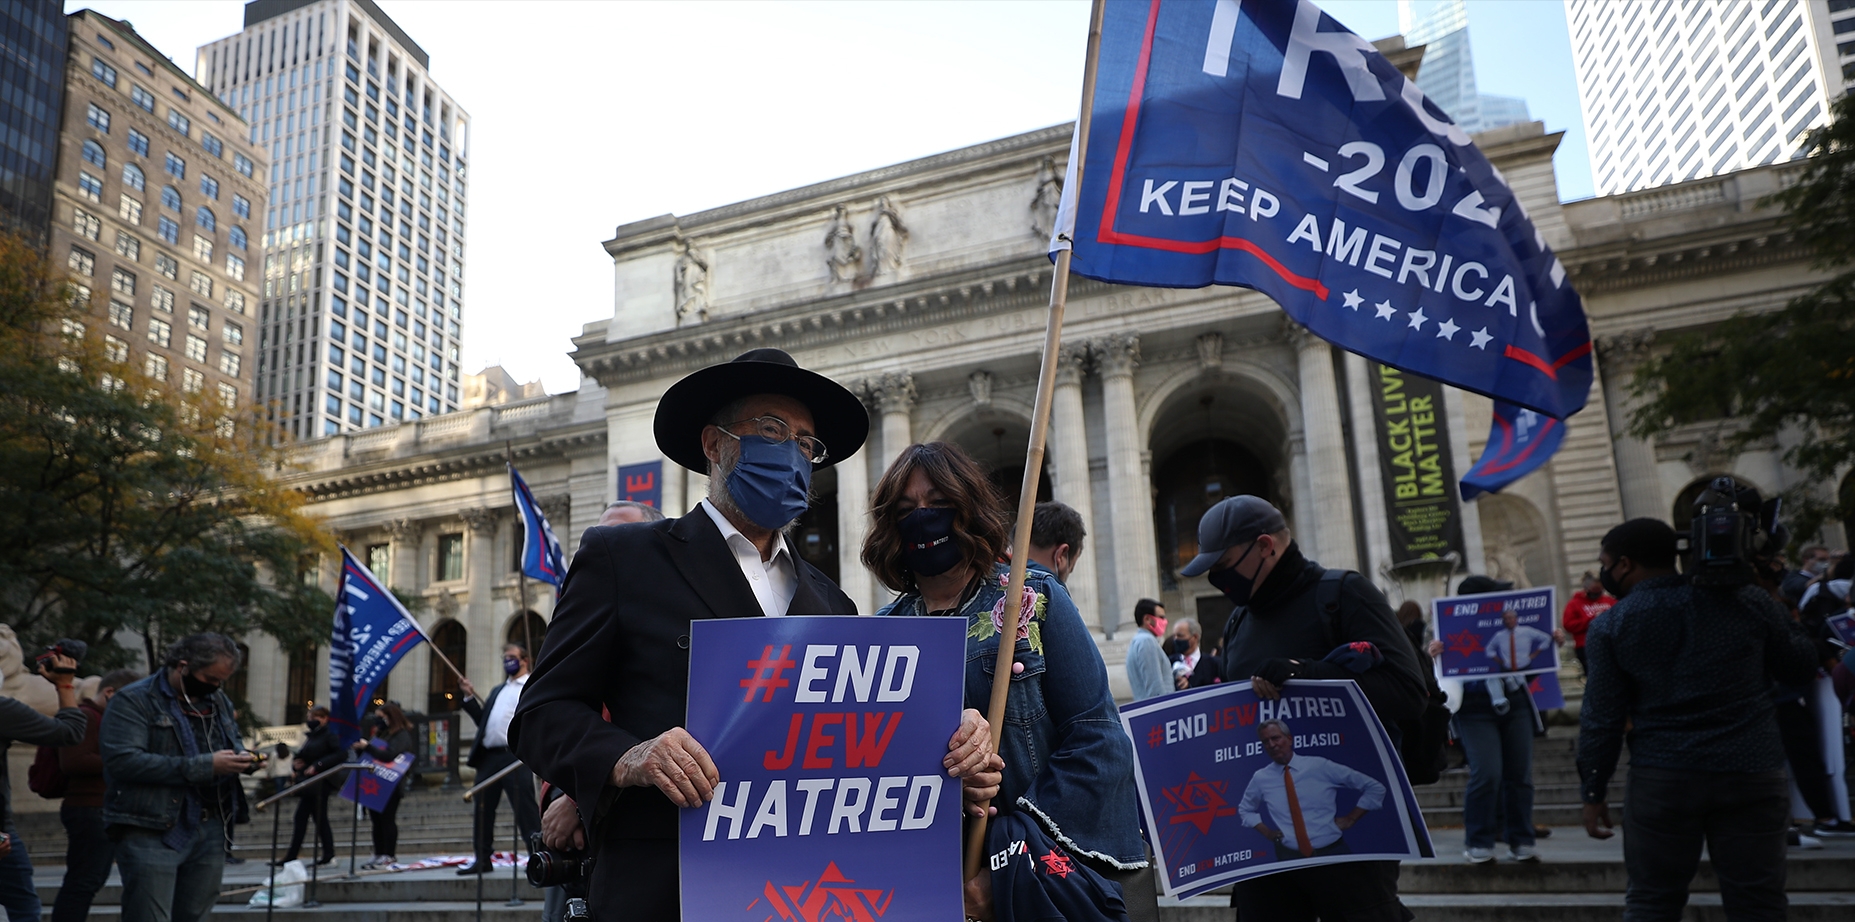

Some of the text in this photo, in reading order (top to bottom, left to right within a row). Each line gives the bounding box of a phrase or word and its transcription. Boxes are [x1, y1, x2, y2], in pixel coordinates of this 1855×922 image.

[1139, 176, 1517, 318] KEEP AMERICA
[844, 340, 891, 359] NEW
[911, 326, 967, 347] YORK
[982, 310, 1048, 332] PUBLI
[1380, 364, 1418, 499] BLACK LIVE
[1410, 395, 1444, 495] MATTER
[740, 644, 920, 703] #END
[763, 711, 904, 770] JEW
[1215, 747, 1242, 763] BILL
[1246, 742, 1263, 757] DE
[702, 774, 944, 841] HATRED
